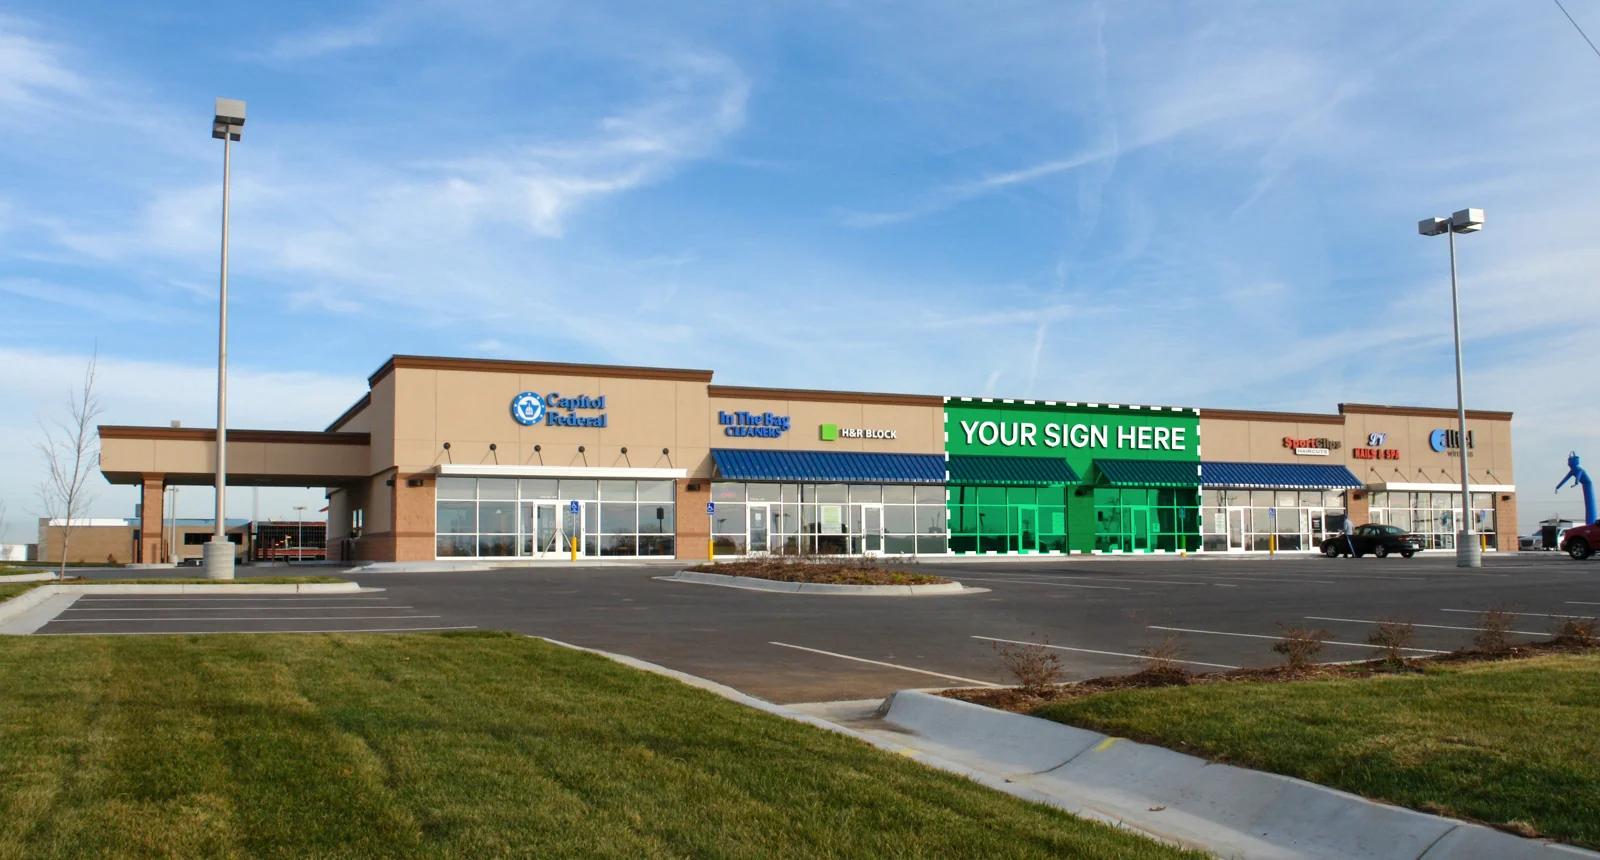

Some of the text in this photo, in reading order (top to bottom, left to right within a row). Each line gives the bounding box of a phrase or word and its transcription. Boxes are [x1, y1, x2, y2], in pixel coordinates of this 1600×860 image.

[546, 392, 606, 411] Capitol
[546, 411, 607, 428] Federal
[718, 411, 790, 431] In The Bag
[725, 426, 782, 438] CLEANERS
[841, 428, 897, 439] H&R BLOCK
[1353, 448, 1376, 460] NAILS
[1385, 449, 1400, 460] SPA
